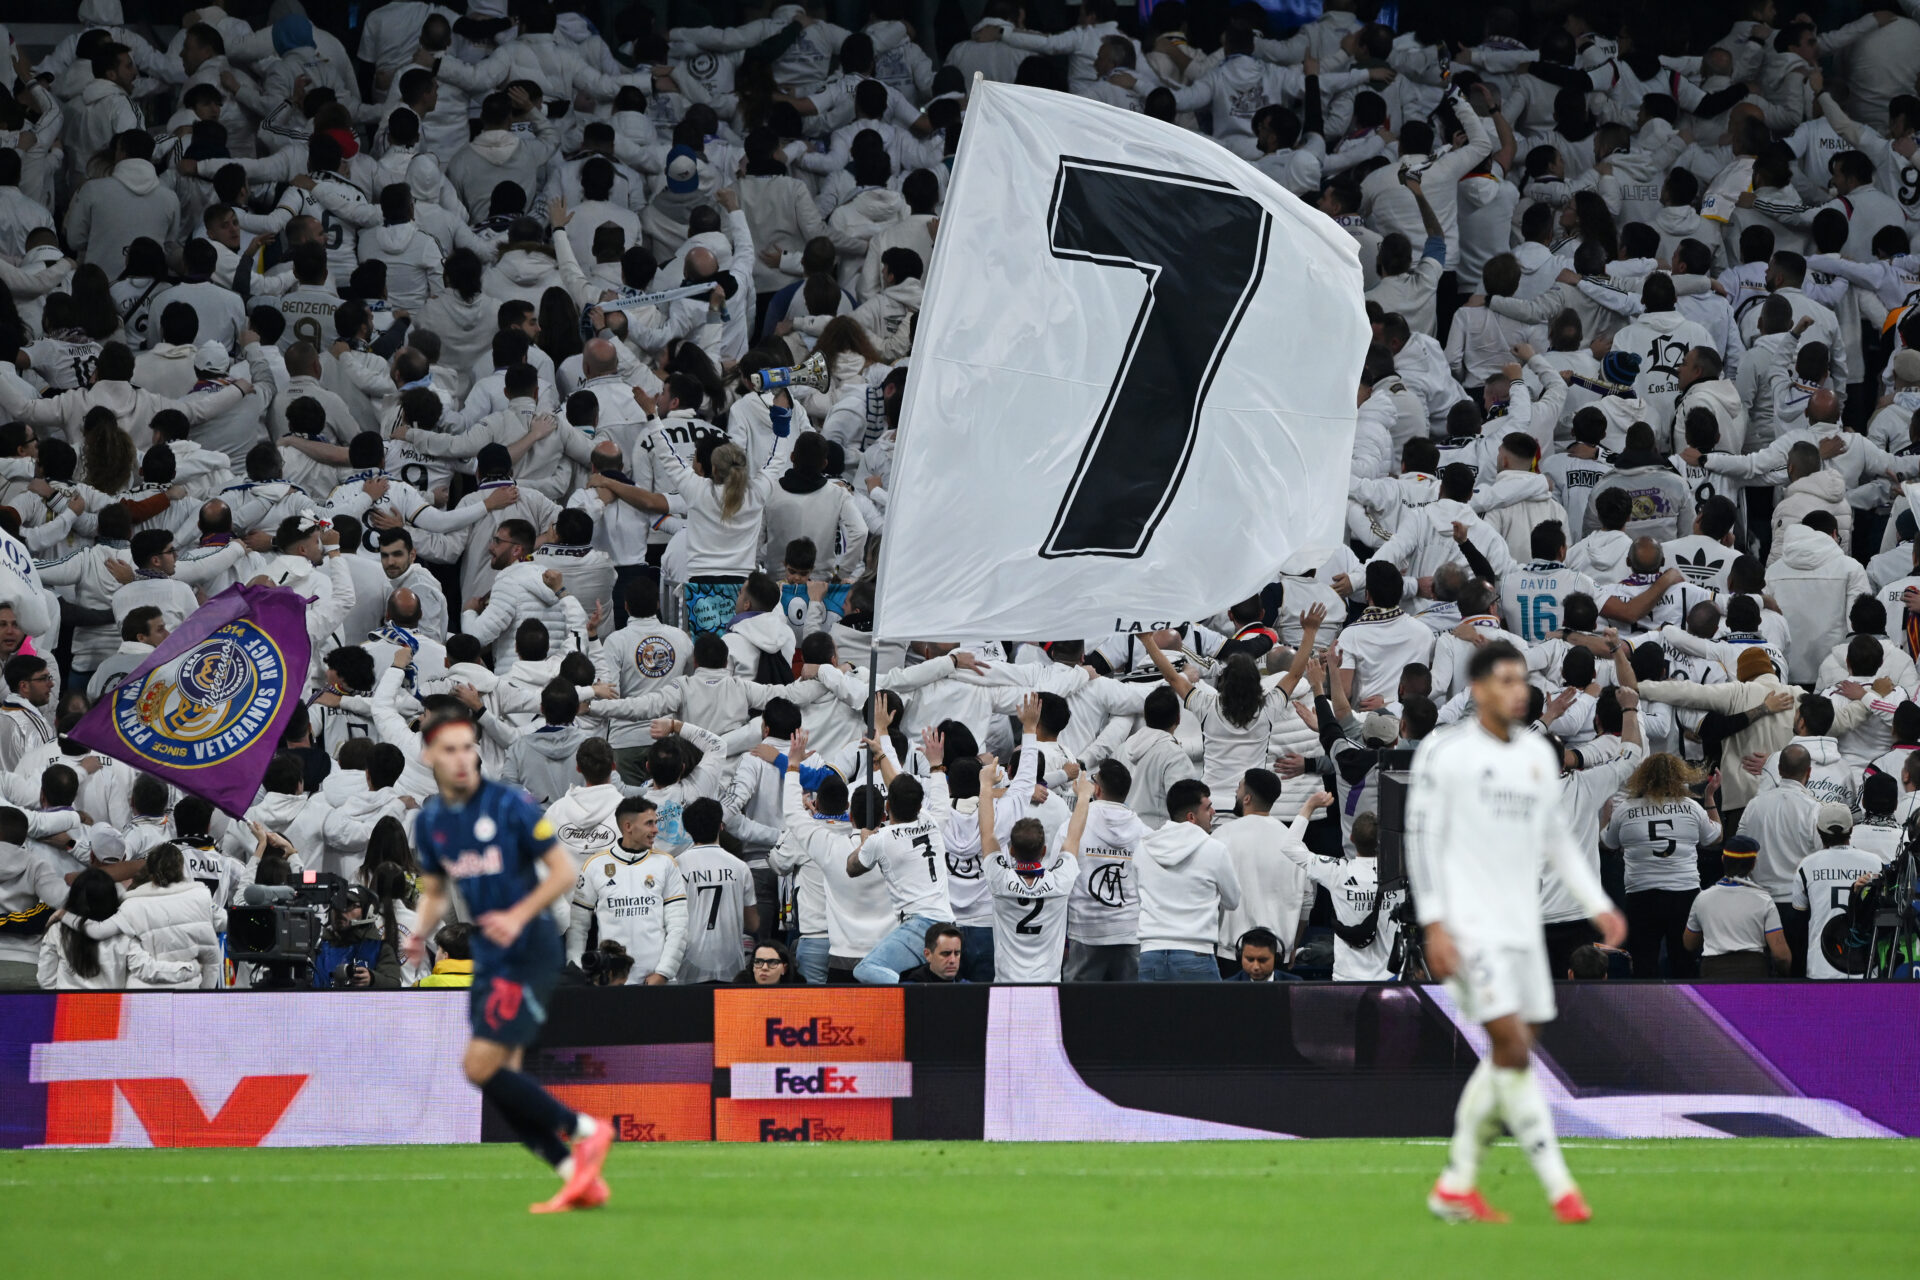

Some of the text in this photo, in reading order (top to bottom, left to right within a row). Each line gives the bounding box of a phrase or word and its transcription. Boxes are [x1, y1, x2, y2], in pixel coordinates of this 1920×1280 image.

[1041, 155, 1272, 558] 7
[1520, 578, 1557, 590] DAVID
[1517, 595, 1557, 641] 16
[193, 638, 279, 760] VETERANOS RMCF
[121, 699, 153, 745] PEÑA
[151, 741, 188, 757] SINCE
[1806, 776, 1853, 800] nchronic
[1628, 804, 1692, 820] BELLINGHAM
[1648, 820, 1676, 857] 5
[190, 859, 222, 873] RAUL
[682, 870, 712, 884] VINI
[607, 896, 656, 908] Emirates
[615, 907, 650, 918] FLY BETTER
[697, 885, 723, 930] 7
[1016, 898, 1044, 934] 2
[766, 1017, 855, 1048] FedEx
[775, 1067, 859, 1094] FedEx
